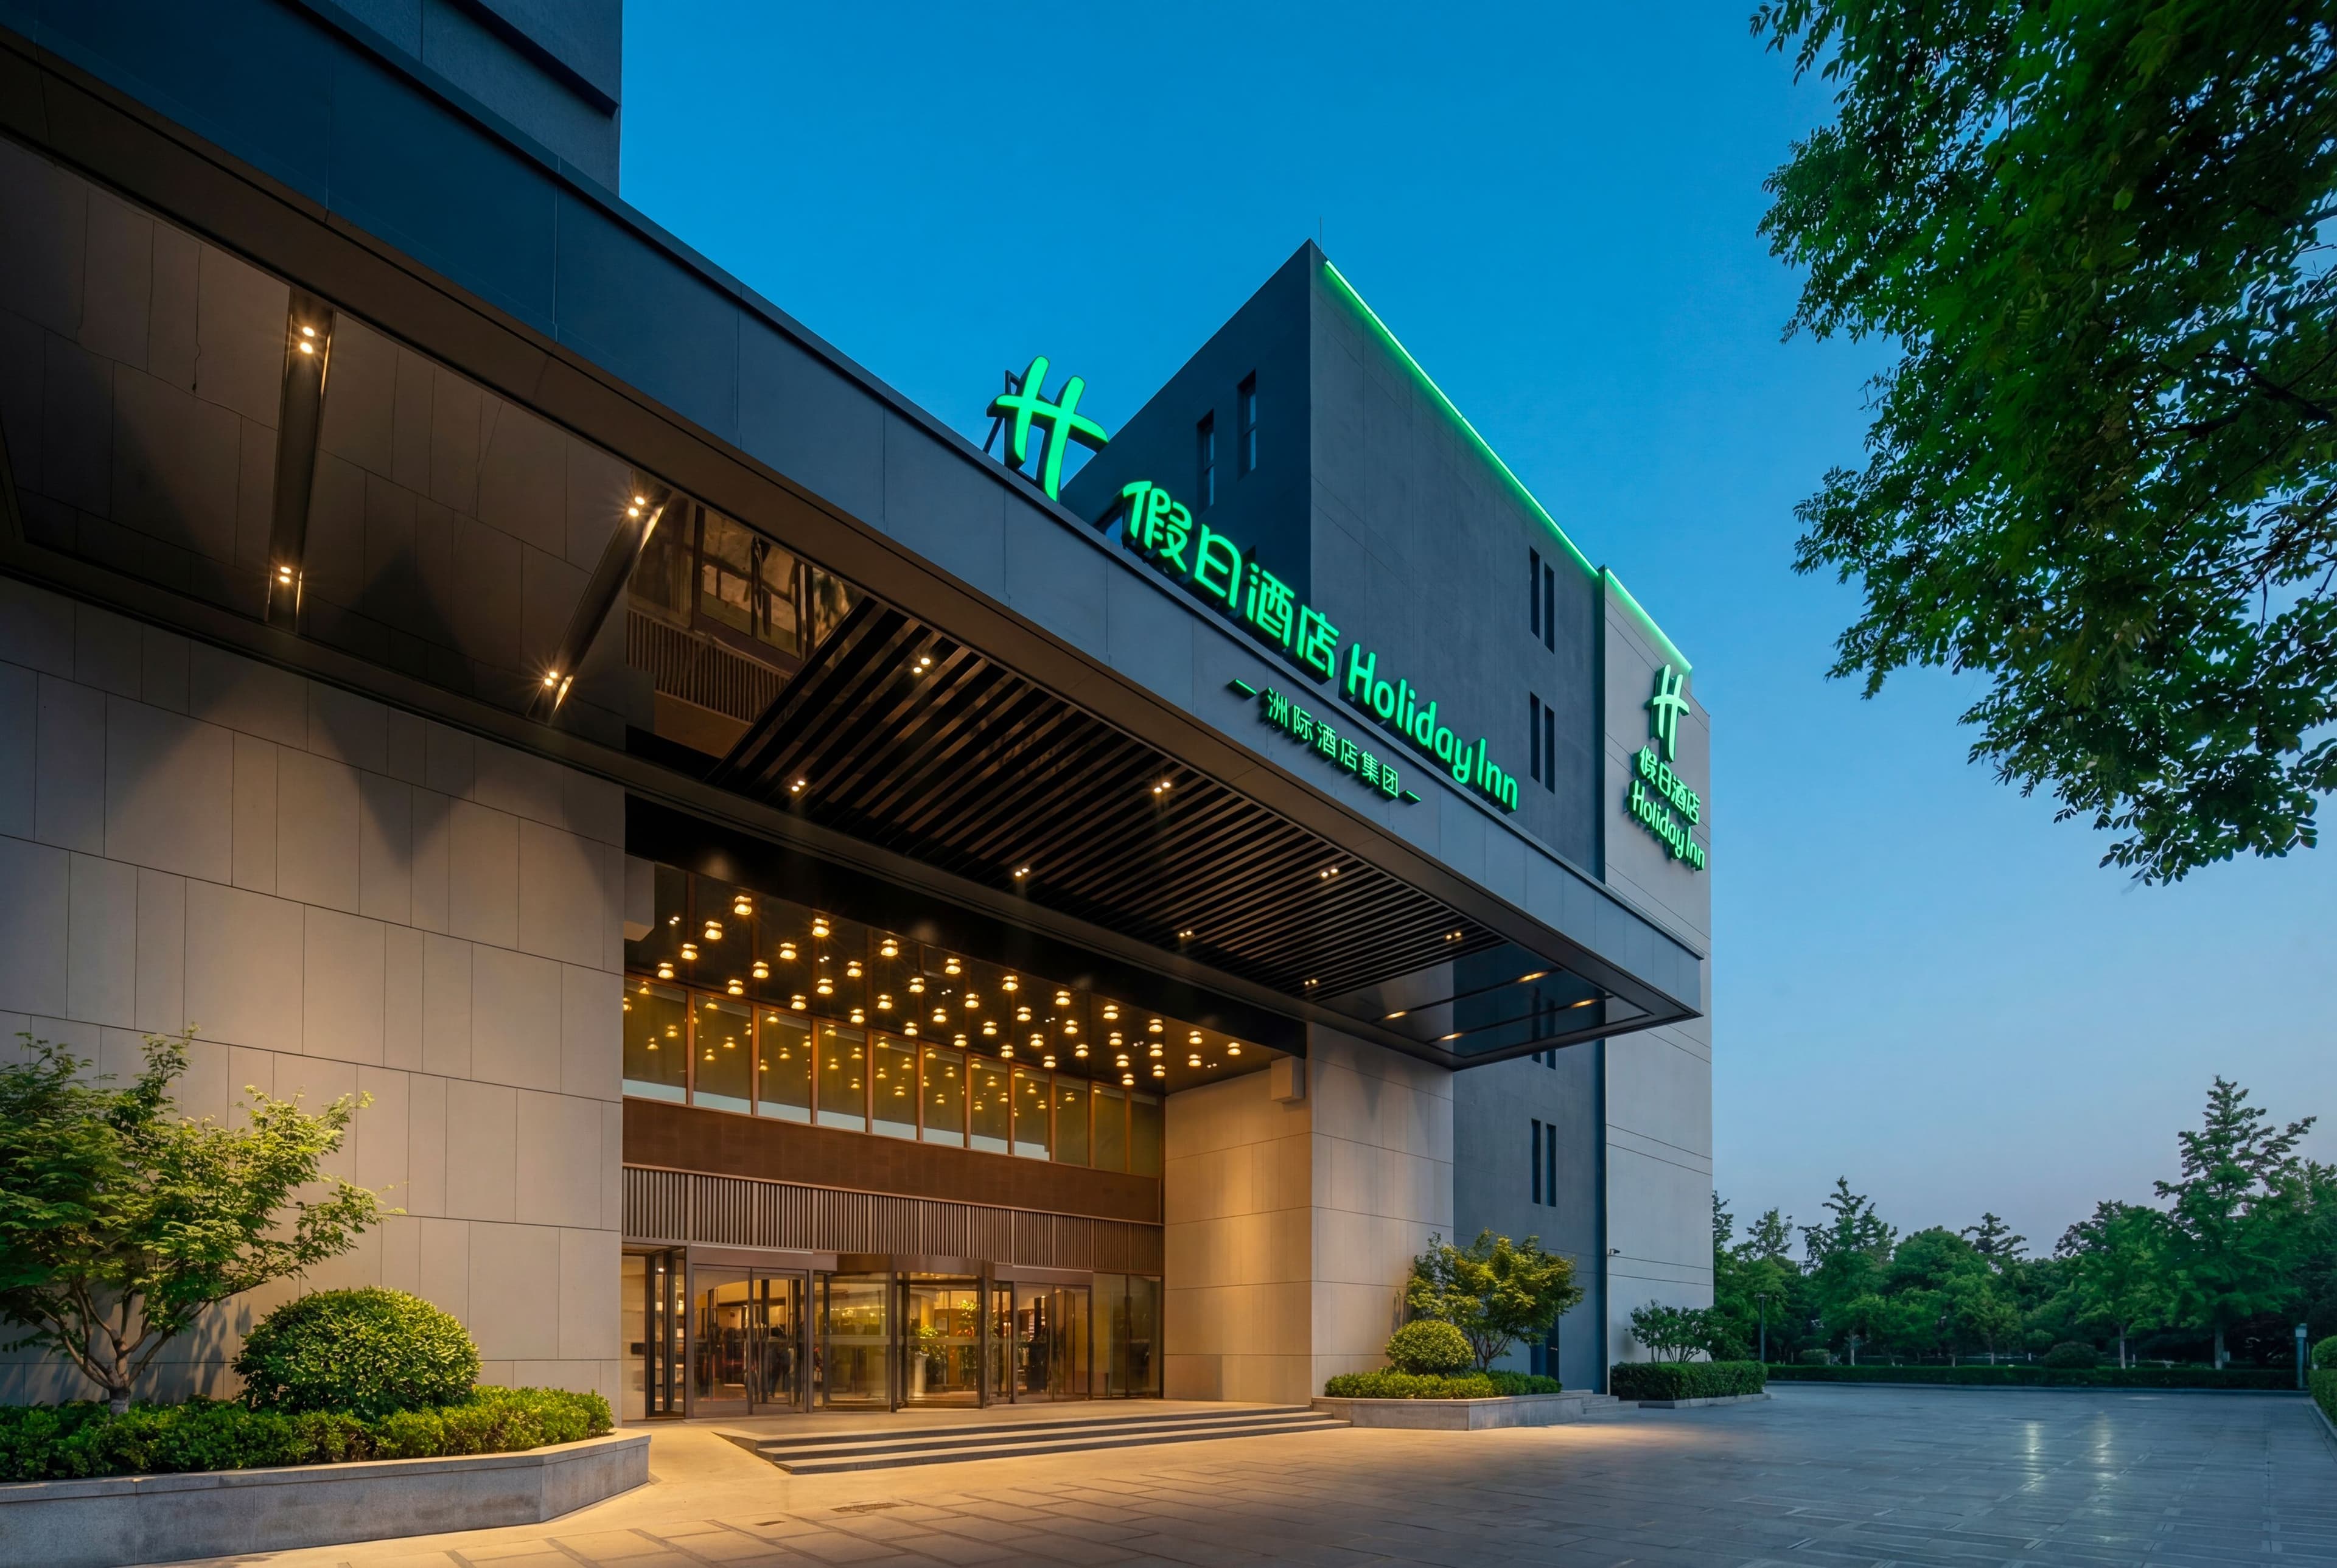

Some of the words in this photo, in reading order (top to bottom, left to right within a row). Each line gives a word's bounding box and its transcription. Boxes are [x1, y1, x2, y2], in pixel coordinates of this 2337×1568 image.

[1122, 481, 1340, 678] 假日酒店
[1268, 686, 1399, 798] 洲际酒店集团
[1347, 643, 1473, 784] Holiday
[1477, 737, 1518, 811] Inn
[1632, 779, 1685, 859] Holiday
[1685, 826, 1705, 870] Inn
[1640, 745, 1700, 825] 假日酒店
